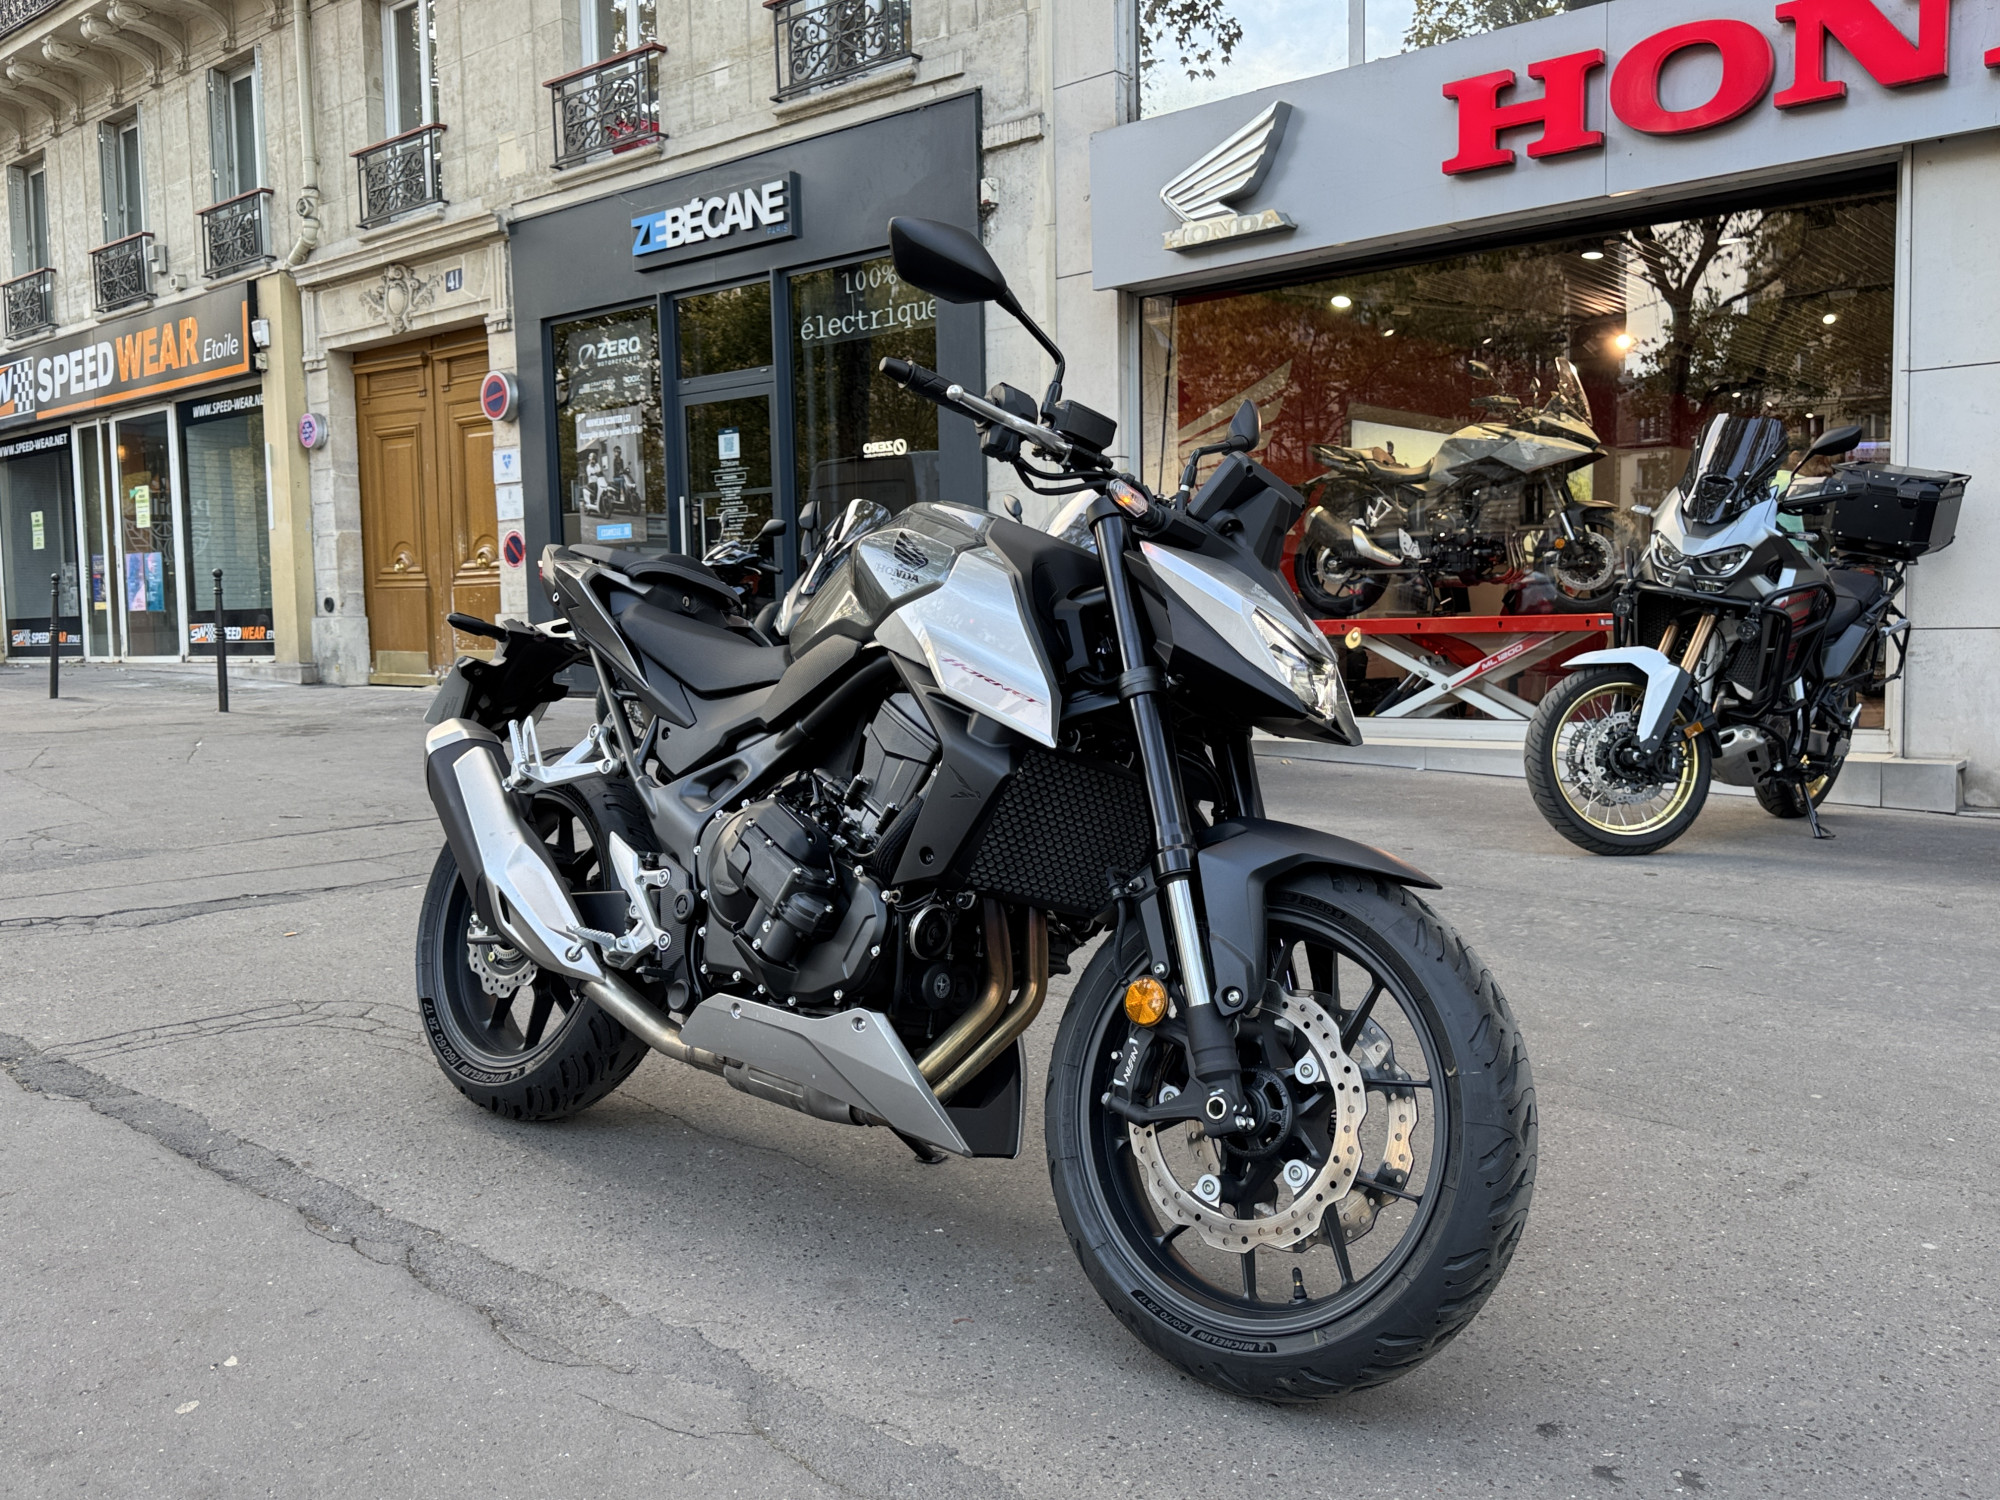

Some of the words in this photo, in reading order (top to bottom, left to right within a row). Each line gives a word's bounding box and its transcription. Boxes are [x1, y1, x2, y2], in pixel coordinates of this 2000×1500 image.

[1441, 0, 2000, 176] HON
[1162, 209, 1284, 250] HONDA
[447, 270, 460, 289] 41
[800, 298, 937, 341] électrique
[202, 333, 238, 363] Etoile
[597, 336, 641, 359] ZERO
[0, 433, 68, 457] WW.SPEED-WEAR.NET
[874, 563, 919, 584] HONDA
[1481, 644, 1523, 671] ML1200
[423, 1002, 434, 1014] 17
[428, 1017, 438, 1031] ZR
[435, 1033, 459, 1064] 160/60
[459, 1065, 508, 1083] MICHELIN
[1137, 1295, 1149, 1305] 17
[1147, 1303, 1160, 1314] ZR
[1160, 1311, 1189, 1333] 120/70
[1197, 1331, 1256, 1352] MICHELIN
